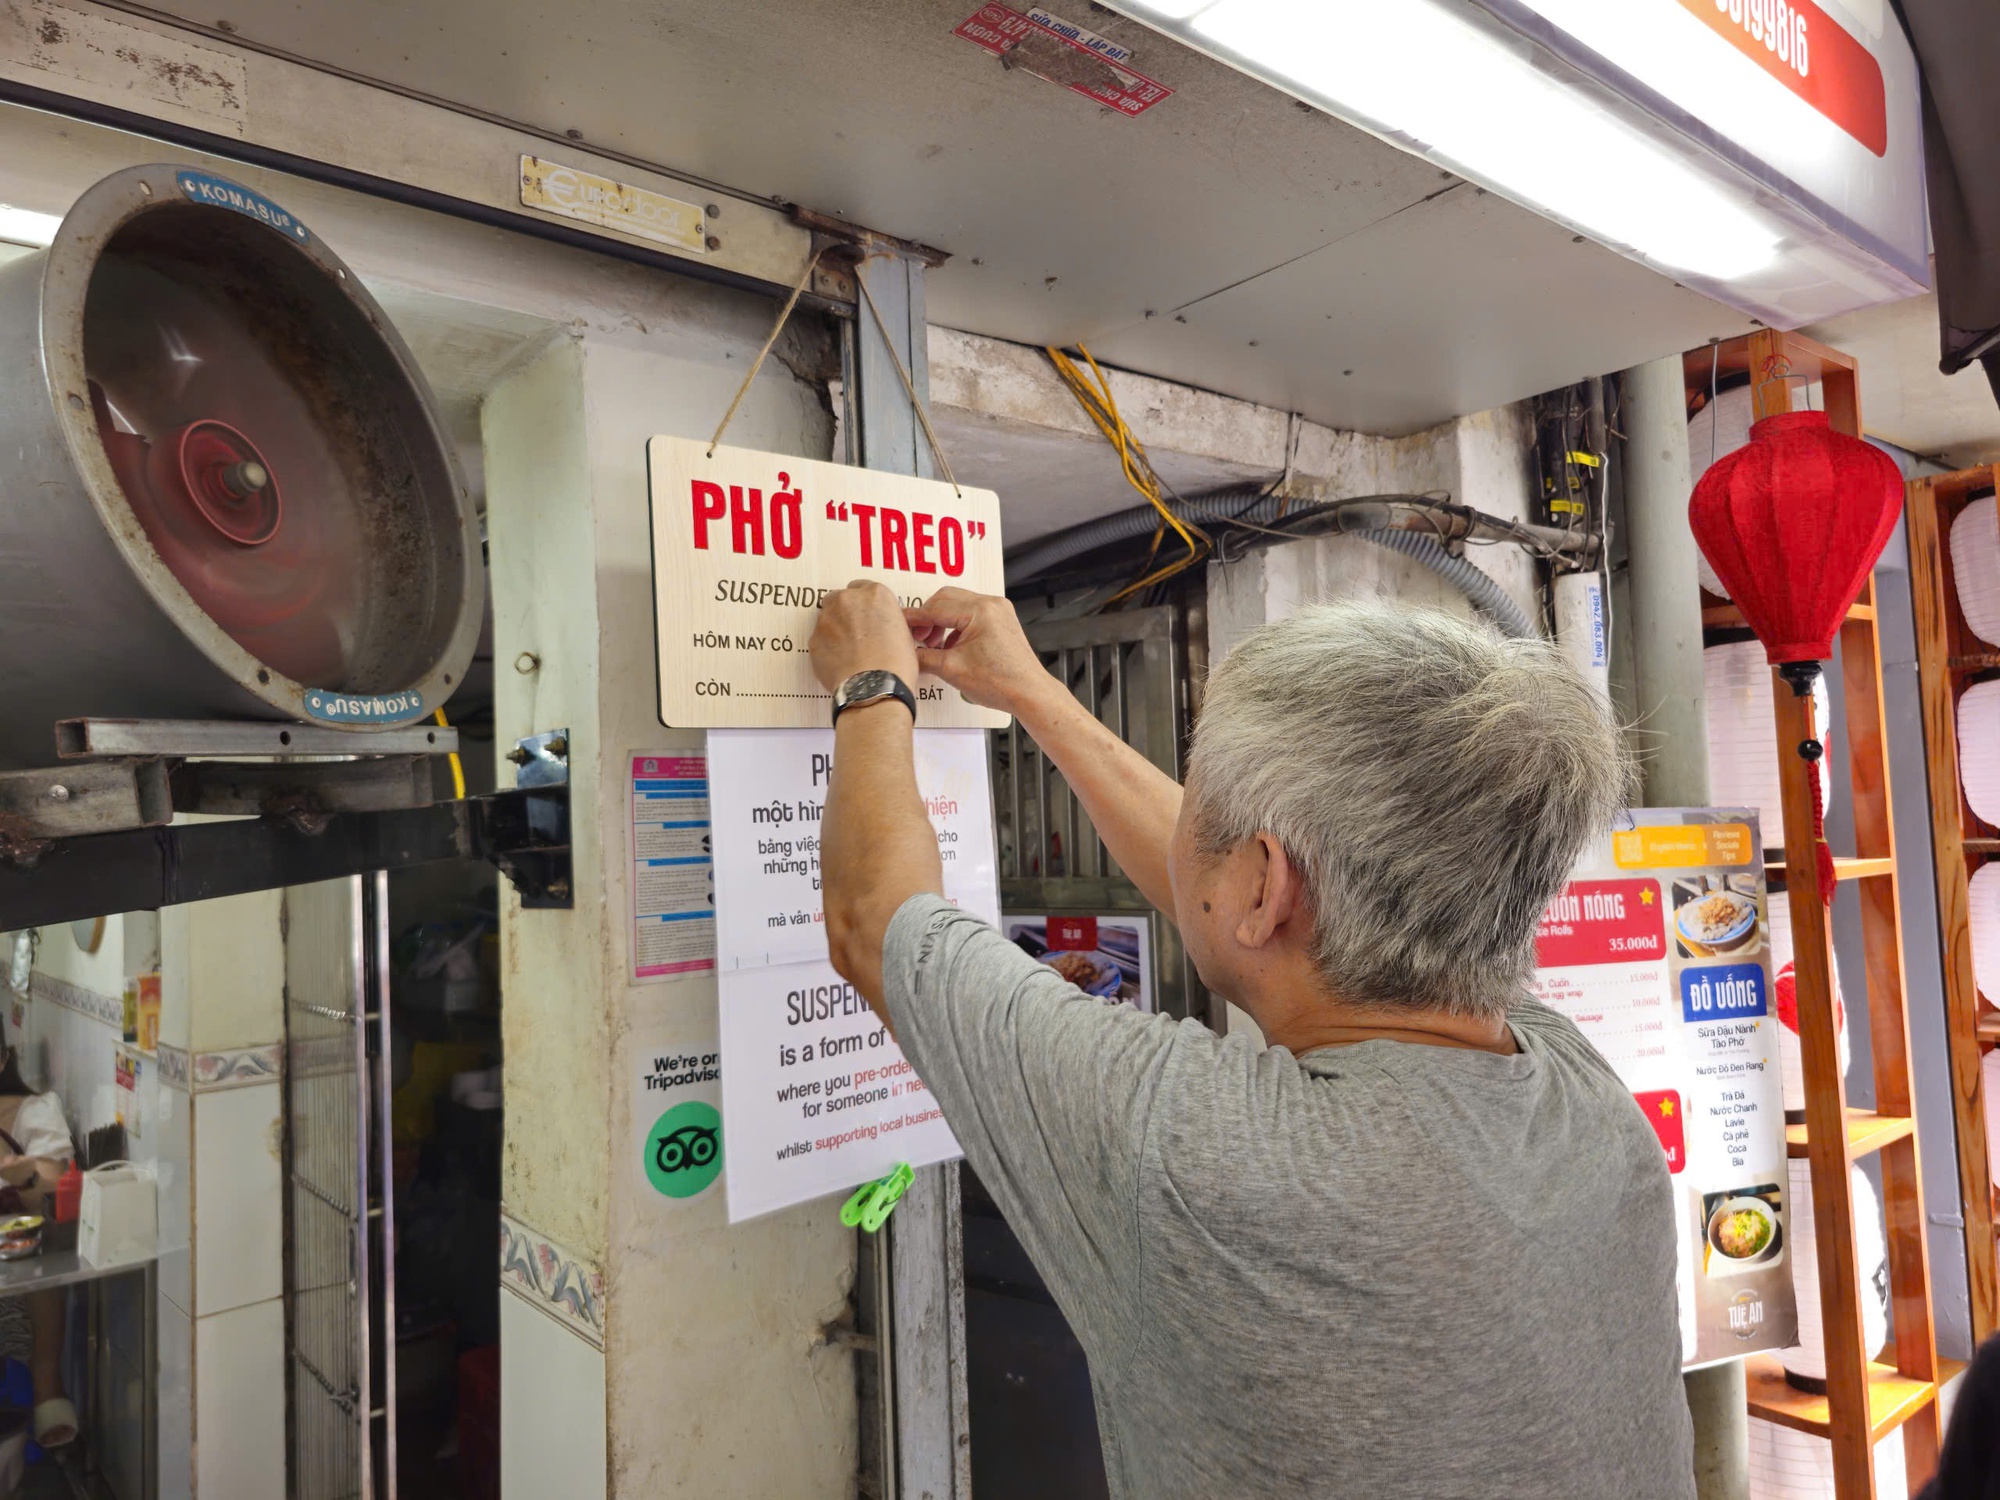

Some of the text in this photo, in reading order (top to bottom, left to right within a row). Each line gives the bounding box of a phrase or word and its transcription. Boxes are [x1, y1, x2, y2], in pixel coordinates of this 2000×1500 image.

[691, 471, 803, 560] PHỞ
[714, 579, 836, 609] SUSPENDE
[693, 630, 793, 652] HÔM NAY CÓ
[695, 678, 731, 697] CÒN
[811, 753, 834, 787] PH
[752, 799, 794, 829] một
[798, 799, 825, 822] hìn
[763, 857, 808, 876] những
[940, 849, 957, 861] ơn
[1722, 851, 1736, 861] Tips
[1583, 890, 1626, 921] NÓNG
[768, 912, 787, 928] mà
[786, 982, 874, 1026] SUSPEN
[1690, 973, 1757, 1012] ĐỒ UỐNG
[780, 1026, 886, 1067] is a form of
[644, 1066, 719, 1092] Tripadvis
[777, 1081, 821, 1103] where
[825, 1074, 851, 1096] you
[803, 1101, 822, 1119] for
[826, 1086, 889, 1113] someone
[1733, 1102, 1758, 1113] Chanh
[777, 1107, 945, 1161] whilst supporting local busines
[1725, 1118, 1745, 1128] Lavie
[1727, 1144, 1747, 1154] Coca
[1732, 1157, 1744, 1167] Bia
[1749, 1301, 1764, 1325] AN
